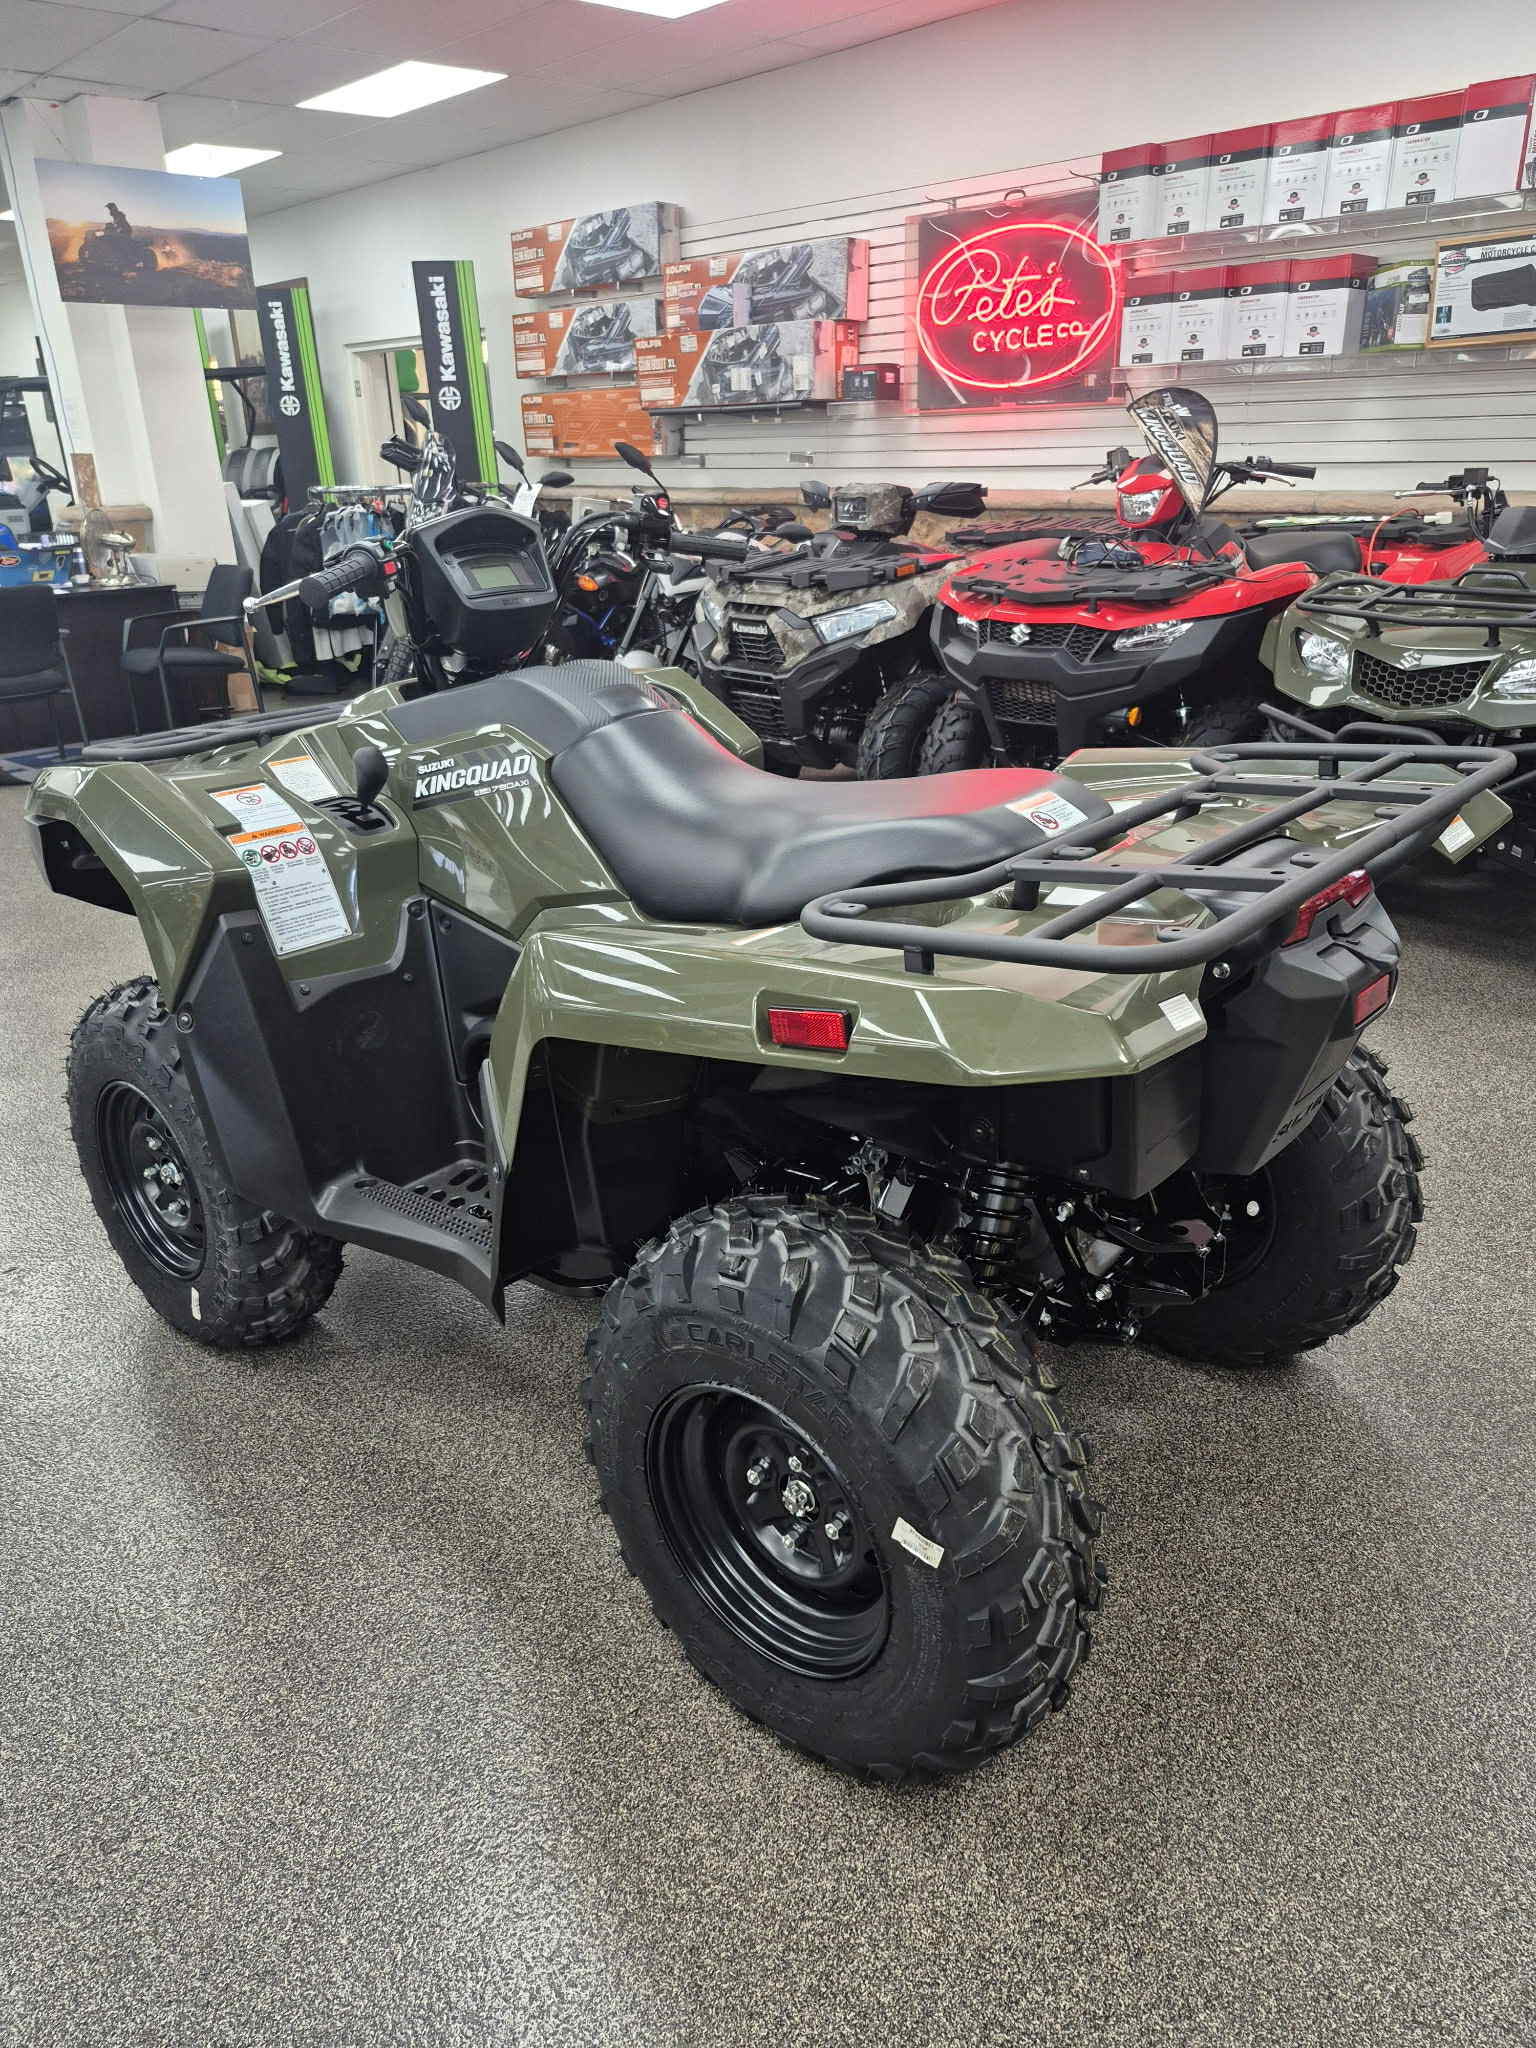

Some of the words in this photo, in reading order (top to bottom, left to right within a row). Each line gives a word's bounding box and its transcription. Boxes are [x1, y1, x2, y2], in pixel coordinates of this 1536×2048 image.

[1480, 246, 1529, 259] MOTORCYCLE
[931, 248, 1076, 325] Pete's
[267, 301, 296, 392] Kawasaki
[428, 276, 457, 382] Kawasaki
[972, 325, 1054, 352] CYCLE
[1135, 407, 1202, 485] KINGQUAD
[731, 622, 768, 634] Kawasaki
[415, 754, 531, 798] KINGQUAD
[417, 758, 455, 774] SUZUKI
